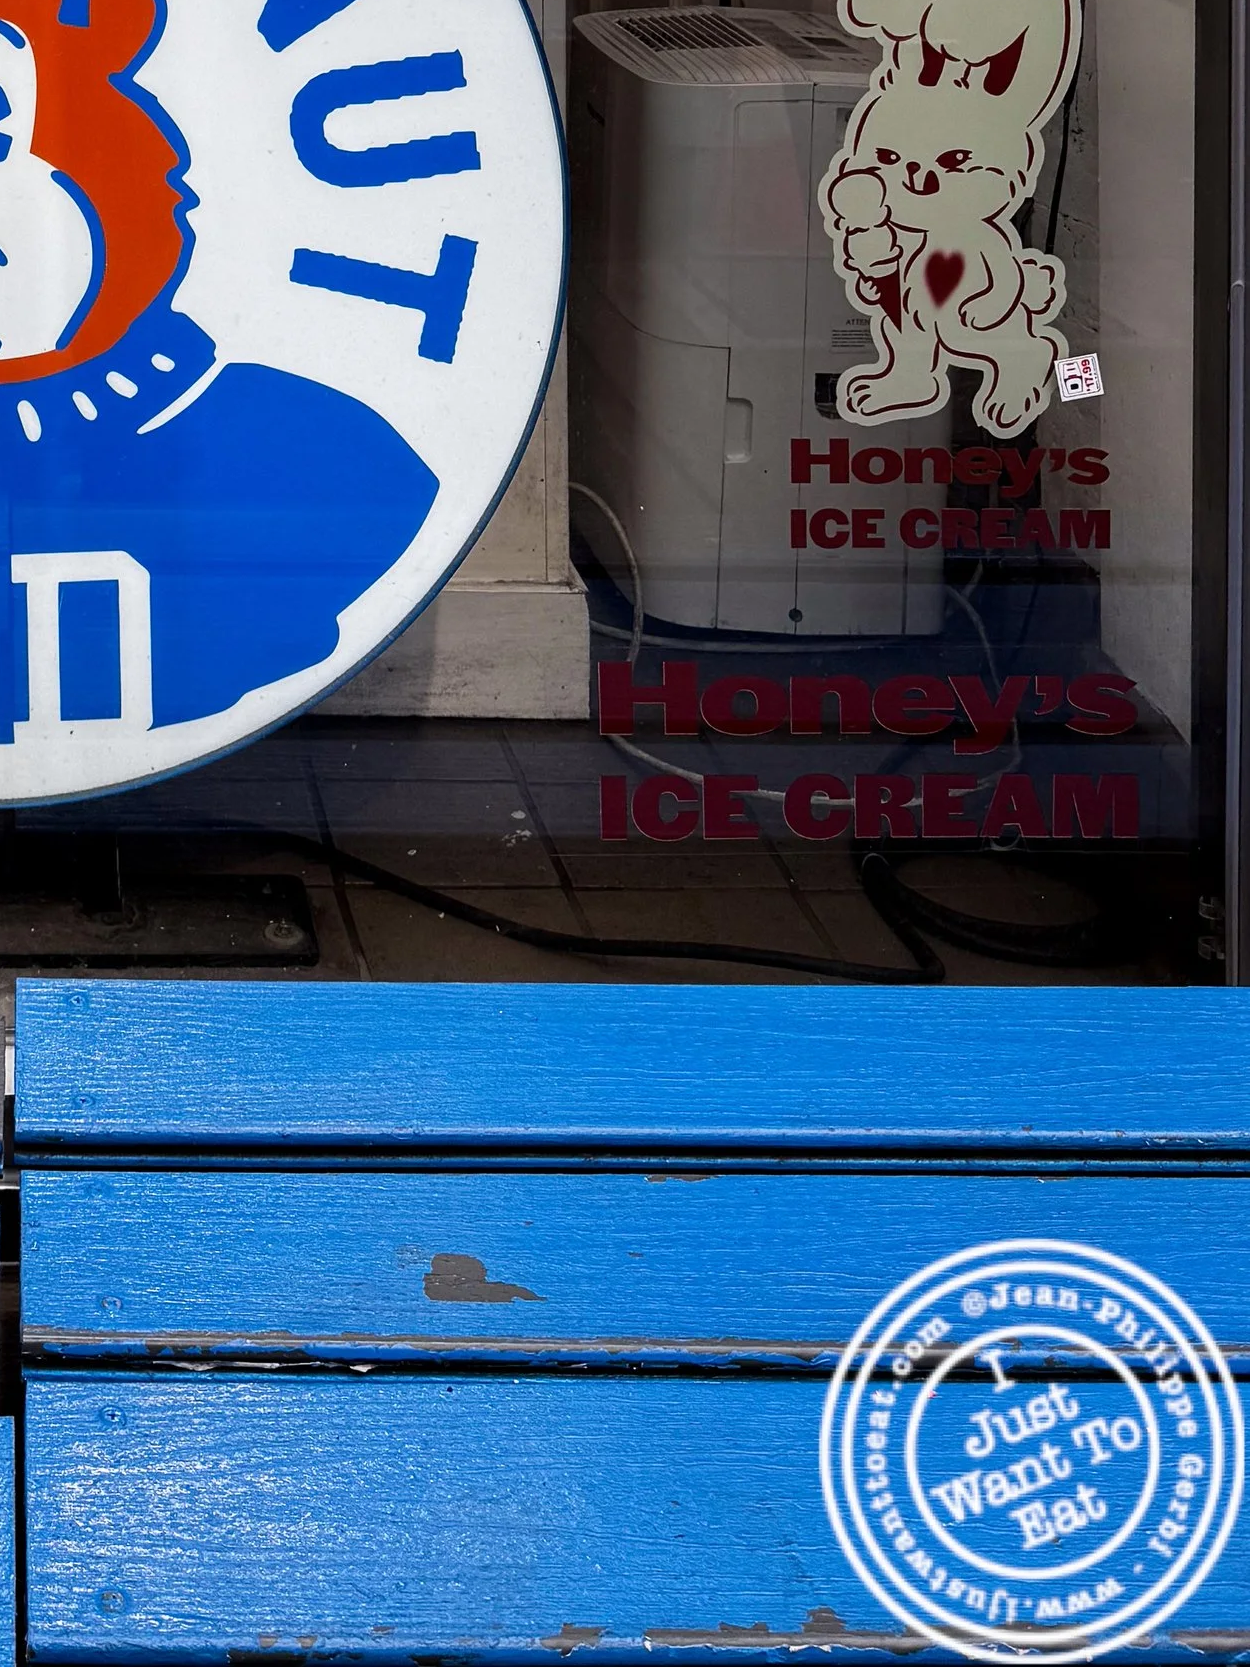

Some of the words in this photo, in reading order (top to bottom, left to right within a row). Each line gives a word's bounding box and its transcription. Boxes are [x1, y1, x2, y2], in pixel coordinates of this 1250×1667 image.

[790, 438, 1111, 498] Honey's
[790, 508, 885, 549] ICE
[899, 508, 1111, 549] CREAM
[597, 660, 1138, 756] Honey's
[599, 773, 759, 842] ICE
[783, 773, 1141, 840] CREAM
